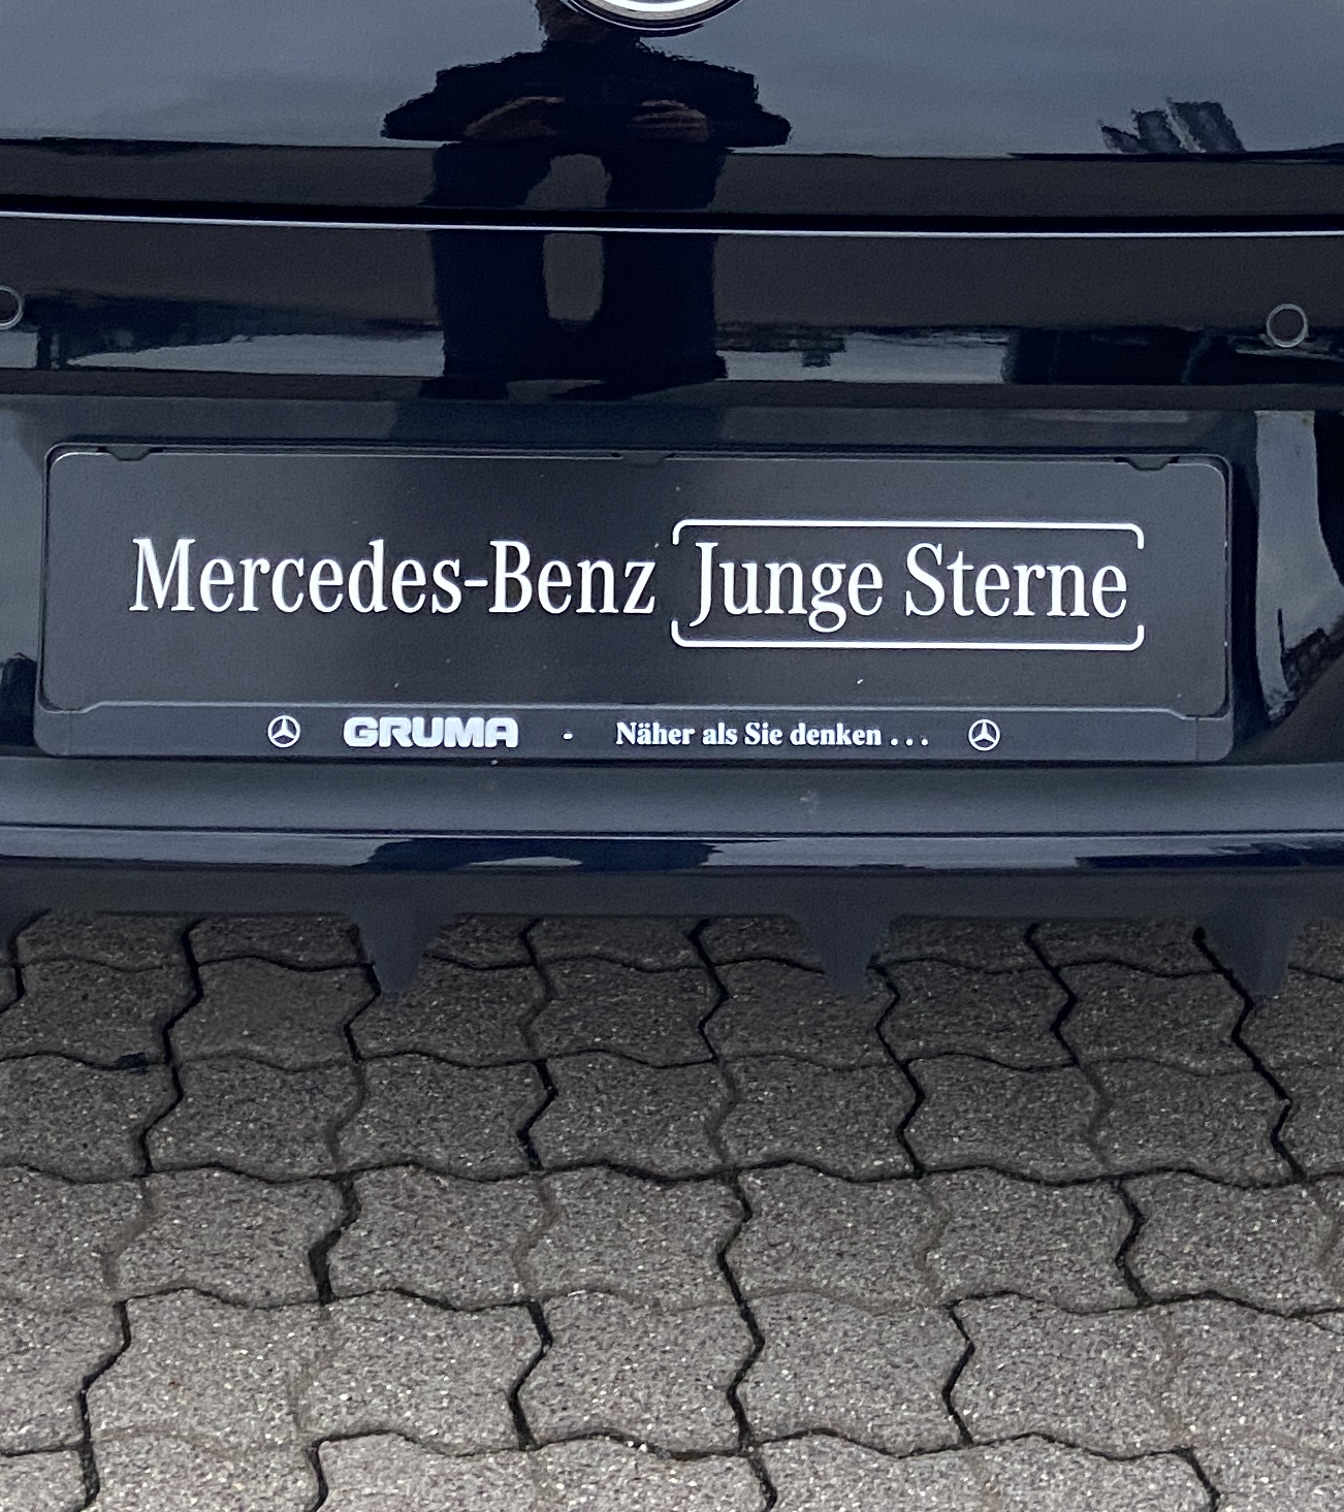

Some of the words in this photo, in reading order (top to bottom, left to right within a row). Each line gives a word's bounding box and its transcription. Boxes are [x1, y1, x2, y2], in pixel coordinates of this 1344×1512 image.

[129, 537, 655, 613] Mercedes-Benz
[690, 542, 883, 632] Junge
[906, 543, 1126, 617] Sterne
[344, 716, 518, 747] GRUMA
[616, 722, 695, 744] Näher
[703, 722, 737, 745] als
[745, 722, 783, 745] Sie
